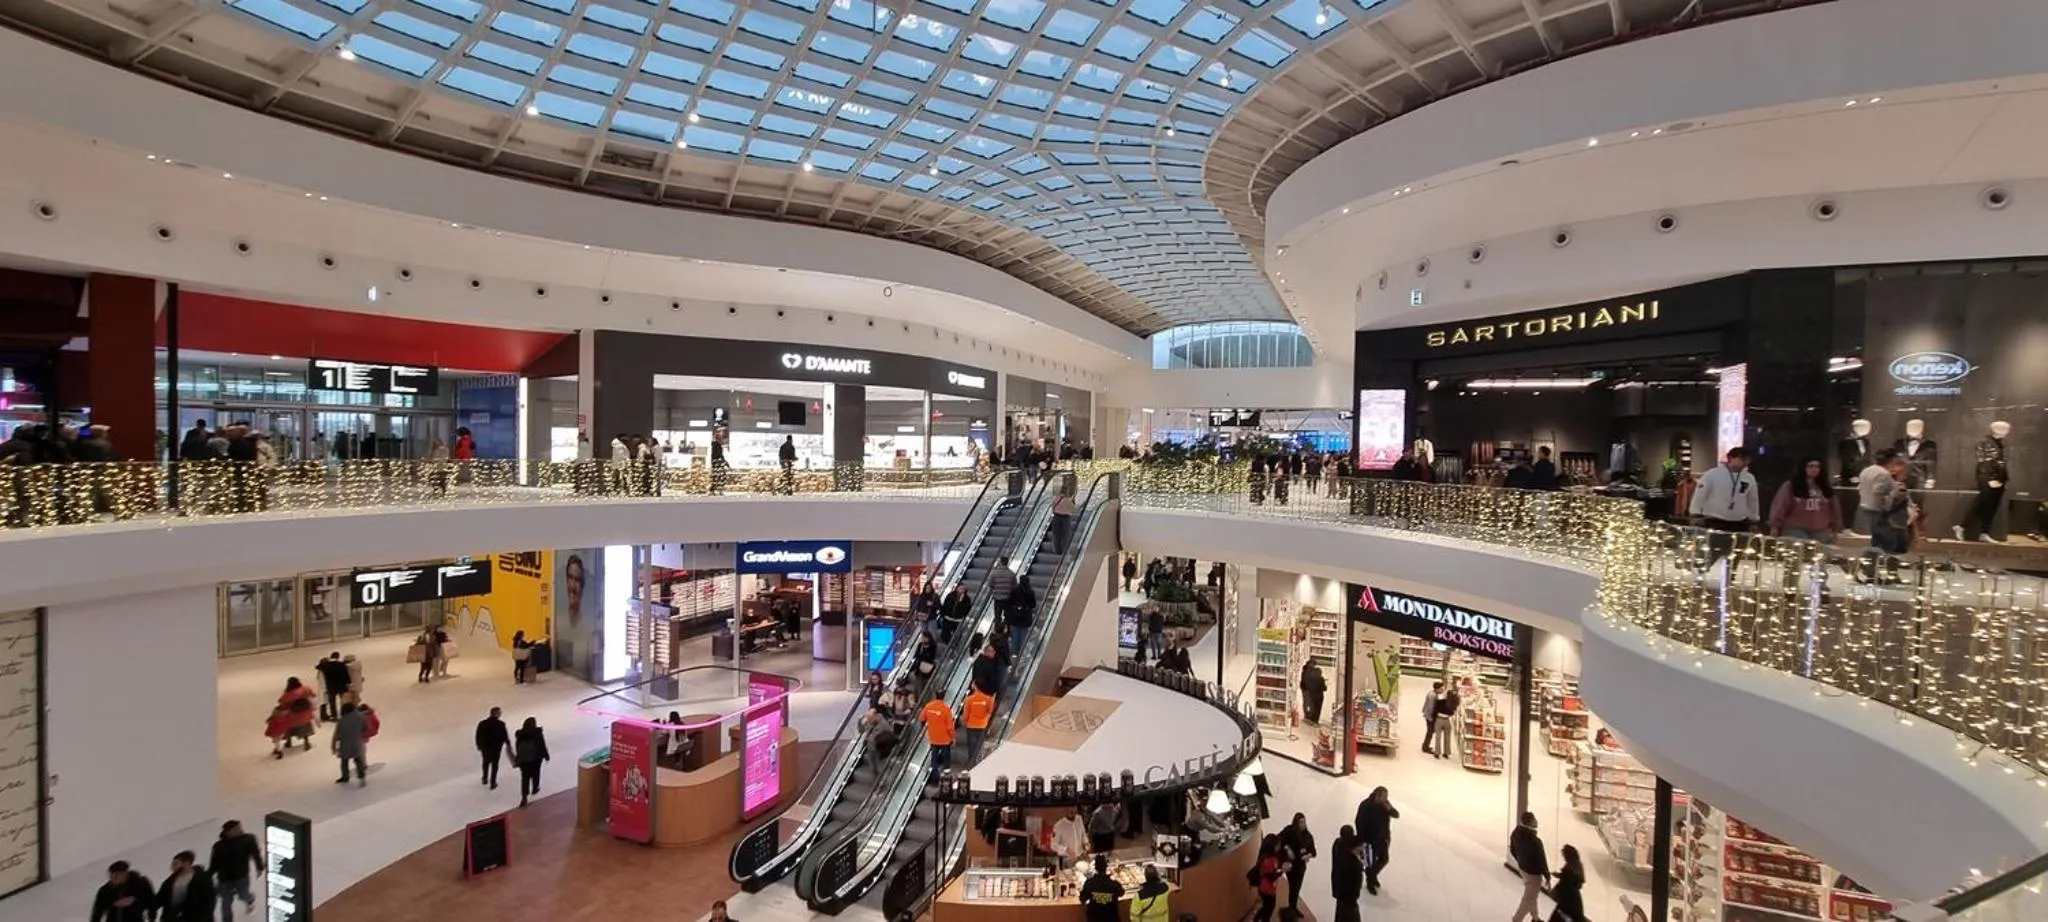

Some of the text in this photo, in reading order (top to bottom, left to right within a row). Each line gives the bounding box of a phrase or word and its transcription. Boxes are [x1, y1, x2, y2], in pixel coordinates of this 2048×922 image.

[1426, 300, 1659, 346] SARTORIANI
[806, 356, 871, 374] D'AMANTE
[322, 369, 334, 388] 1
[743, 551, 813, 562] GrandVision
[362, 583, 379, 604] 0
[1383, 594, 1515, 640] MONDADORI
[1434, 626, 1514, 657] BOOKSTORE
[1144, 744, 1222, 789] CAFFÈ
